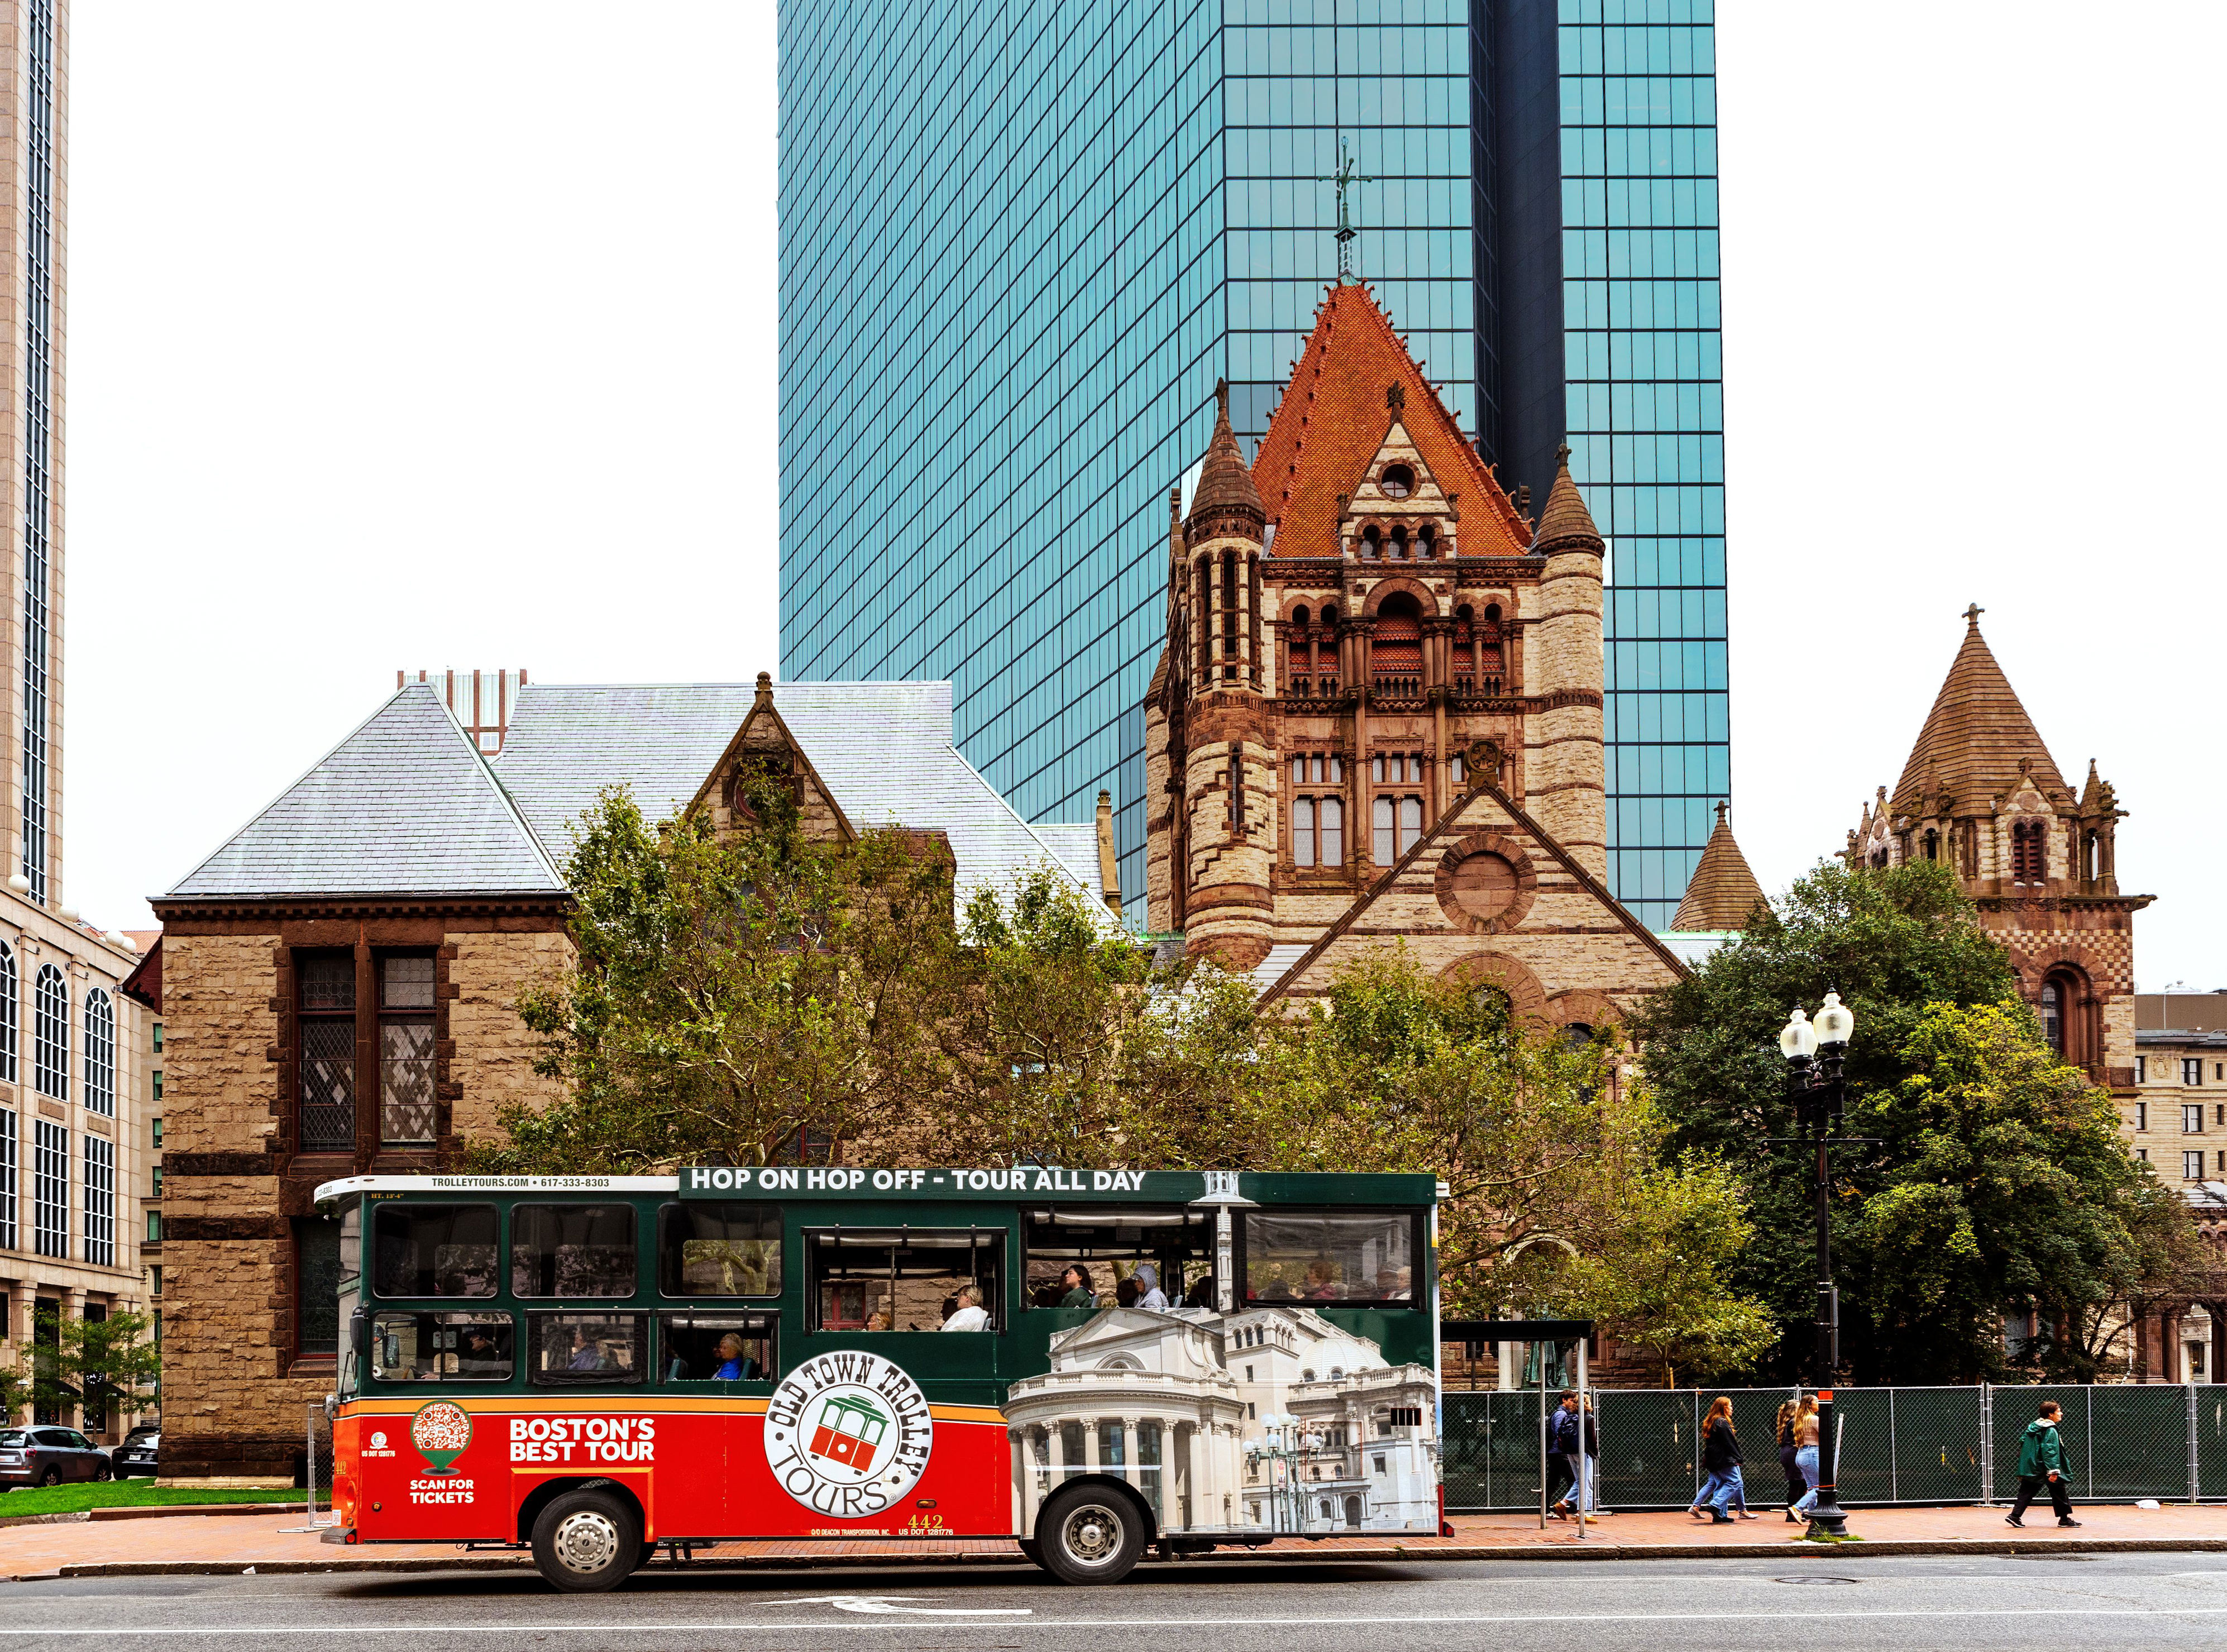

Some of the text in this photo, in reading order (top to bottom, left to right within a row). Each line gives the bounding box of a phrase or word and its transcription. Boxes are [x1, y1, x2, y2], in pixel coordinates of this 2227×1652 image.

[432, 1178, 529, 1187] TROLLEYTOURS.COM
[541, 1178, 610, 1187] 617-333-8303
[691, 1169, 751, 1189] HOP
[758, 1169, 799, 1189] ON
[807, 1169, 865, 1189] HOP
[872, 1170, 925, 1190] OFF
[951, 1170, 1027, 1190] TOUR
[1033, 1171, 1086, 1190] ALL
[1093, 1171, 1146, 1191] DAY
[768, 1354, 930, 1477] OLD TOWN TROLLEY
[510, 1418, 655, 1440] BOSTON'S
[510, 1441, 655, 1462] BEST TOUR
[336, 1461, 346, 1475] 442
[410, 1479, 474, 1490] SCAN FOR
[772, 1444, 887, 1515] TOURS
[409, 1491, 474, 1503] TICKETS
[907, 1514, 944, 1529] 442
